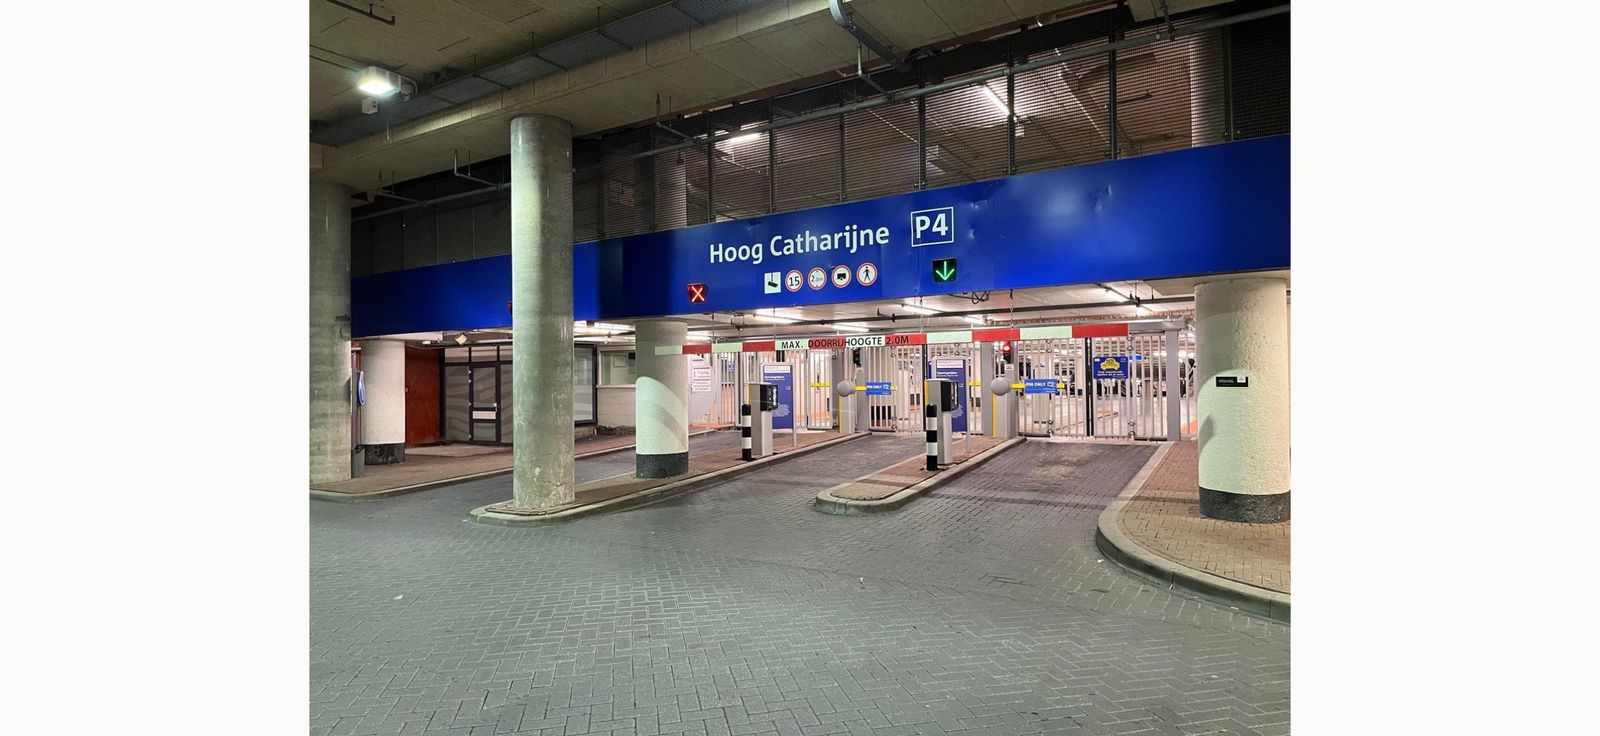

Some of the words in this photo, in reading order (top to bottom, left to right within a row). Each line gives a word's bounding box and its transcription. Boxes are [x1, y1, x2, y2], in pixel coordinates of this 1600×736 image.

[915, 213, 949, 239] P4
[709, 242, 763, 265] Hoog
[770, 225, 890, 258] Catharijne
[788, 275, 801, 287] 15
[781, 340, 804, 349] MAX.
[886, 335, 909, 345] 2.0M
